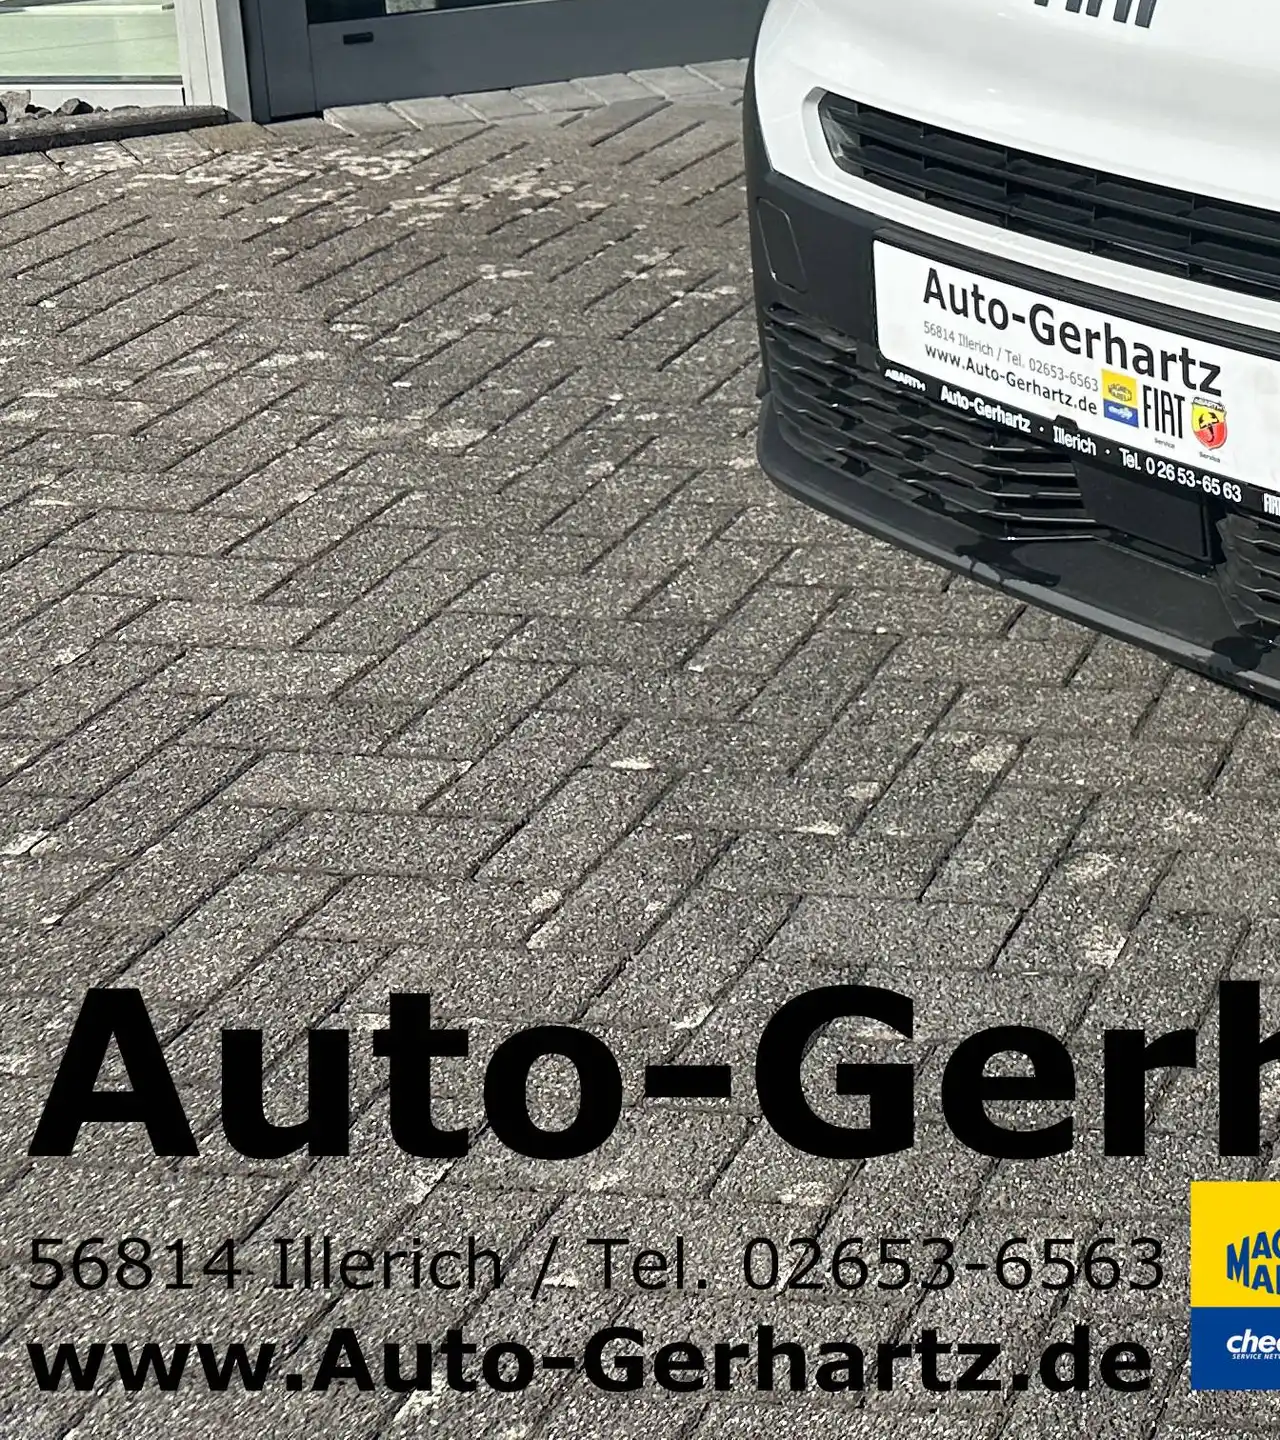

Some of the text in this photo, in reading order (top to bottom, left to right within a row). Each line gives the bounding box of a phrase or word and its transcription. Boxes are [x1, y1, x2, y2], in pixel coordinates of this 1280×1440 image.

[923, 267, 1222, 397] Auto-Gerhartz
[923, 321, 956, 343] 56814
[958, 332, 994, 357] Illerich
[1005, 348, 1025, 368] Tel.
[1029, 358, 1099, 392] 02653-6563
[884, 368, 926, 392] ABARTH
[924, 343, 1098, 415] www.Auto-Gerhartz.de
[1143, 384, 1186, 440] FIAT
[940, 384, 1032, 434] Auto-Gerhartz
[1052, 425, 1097, 457] Illerich
[1119, 447, 1142, 472] Tel.
